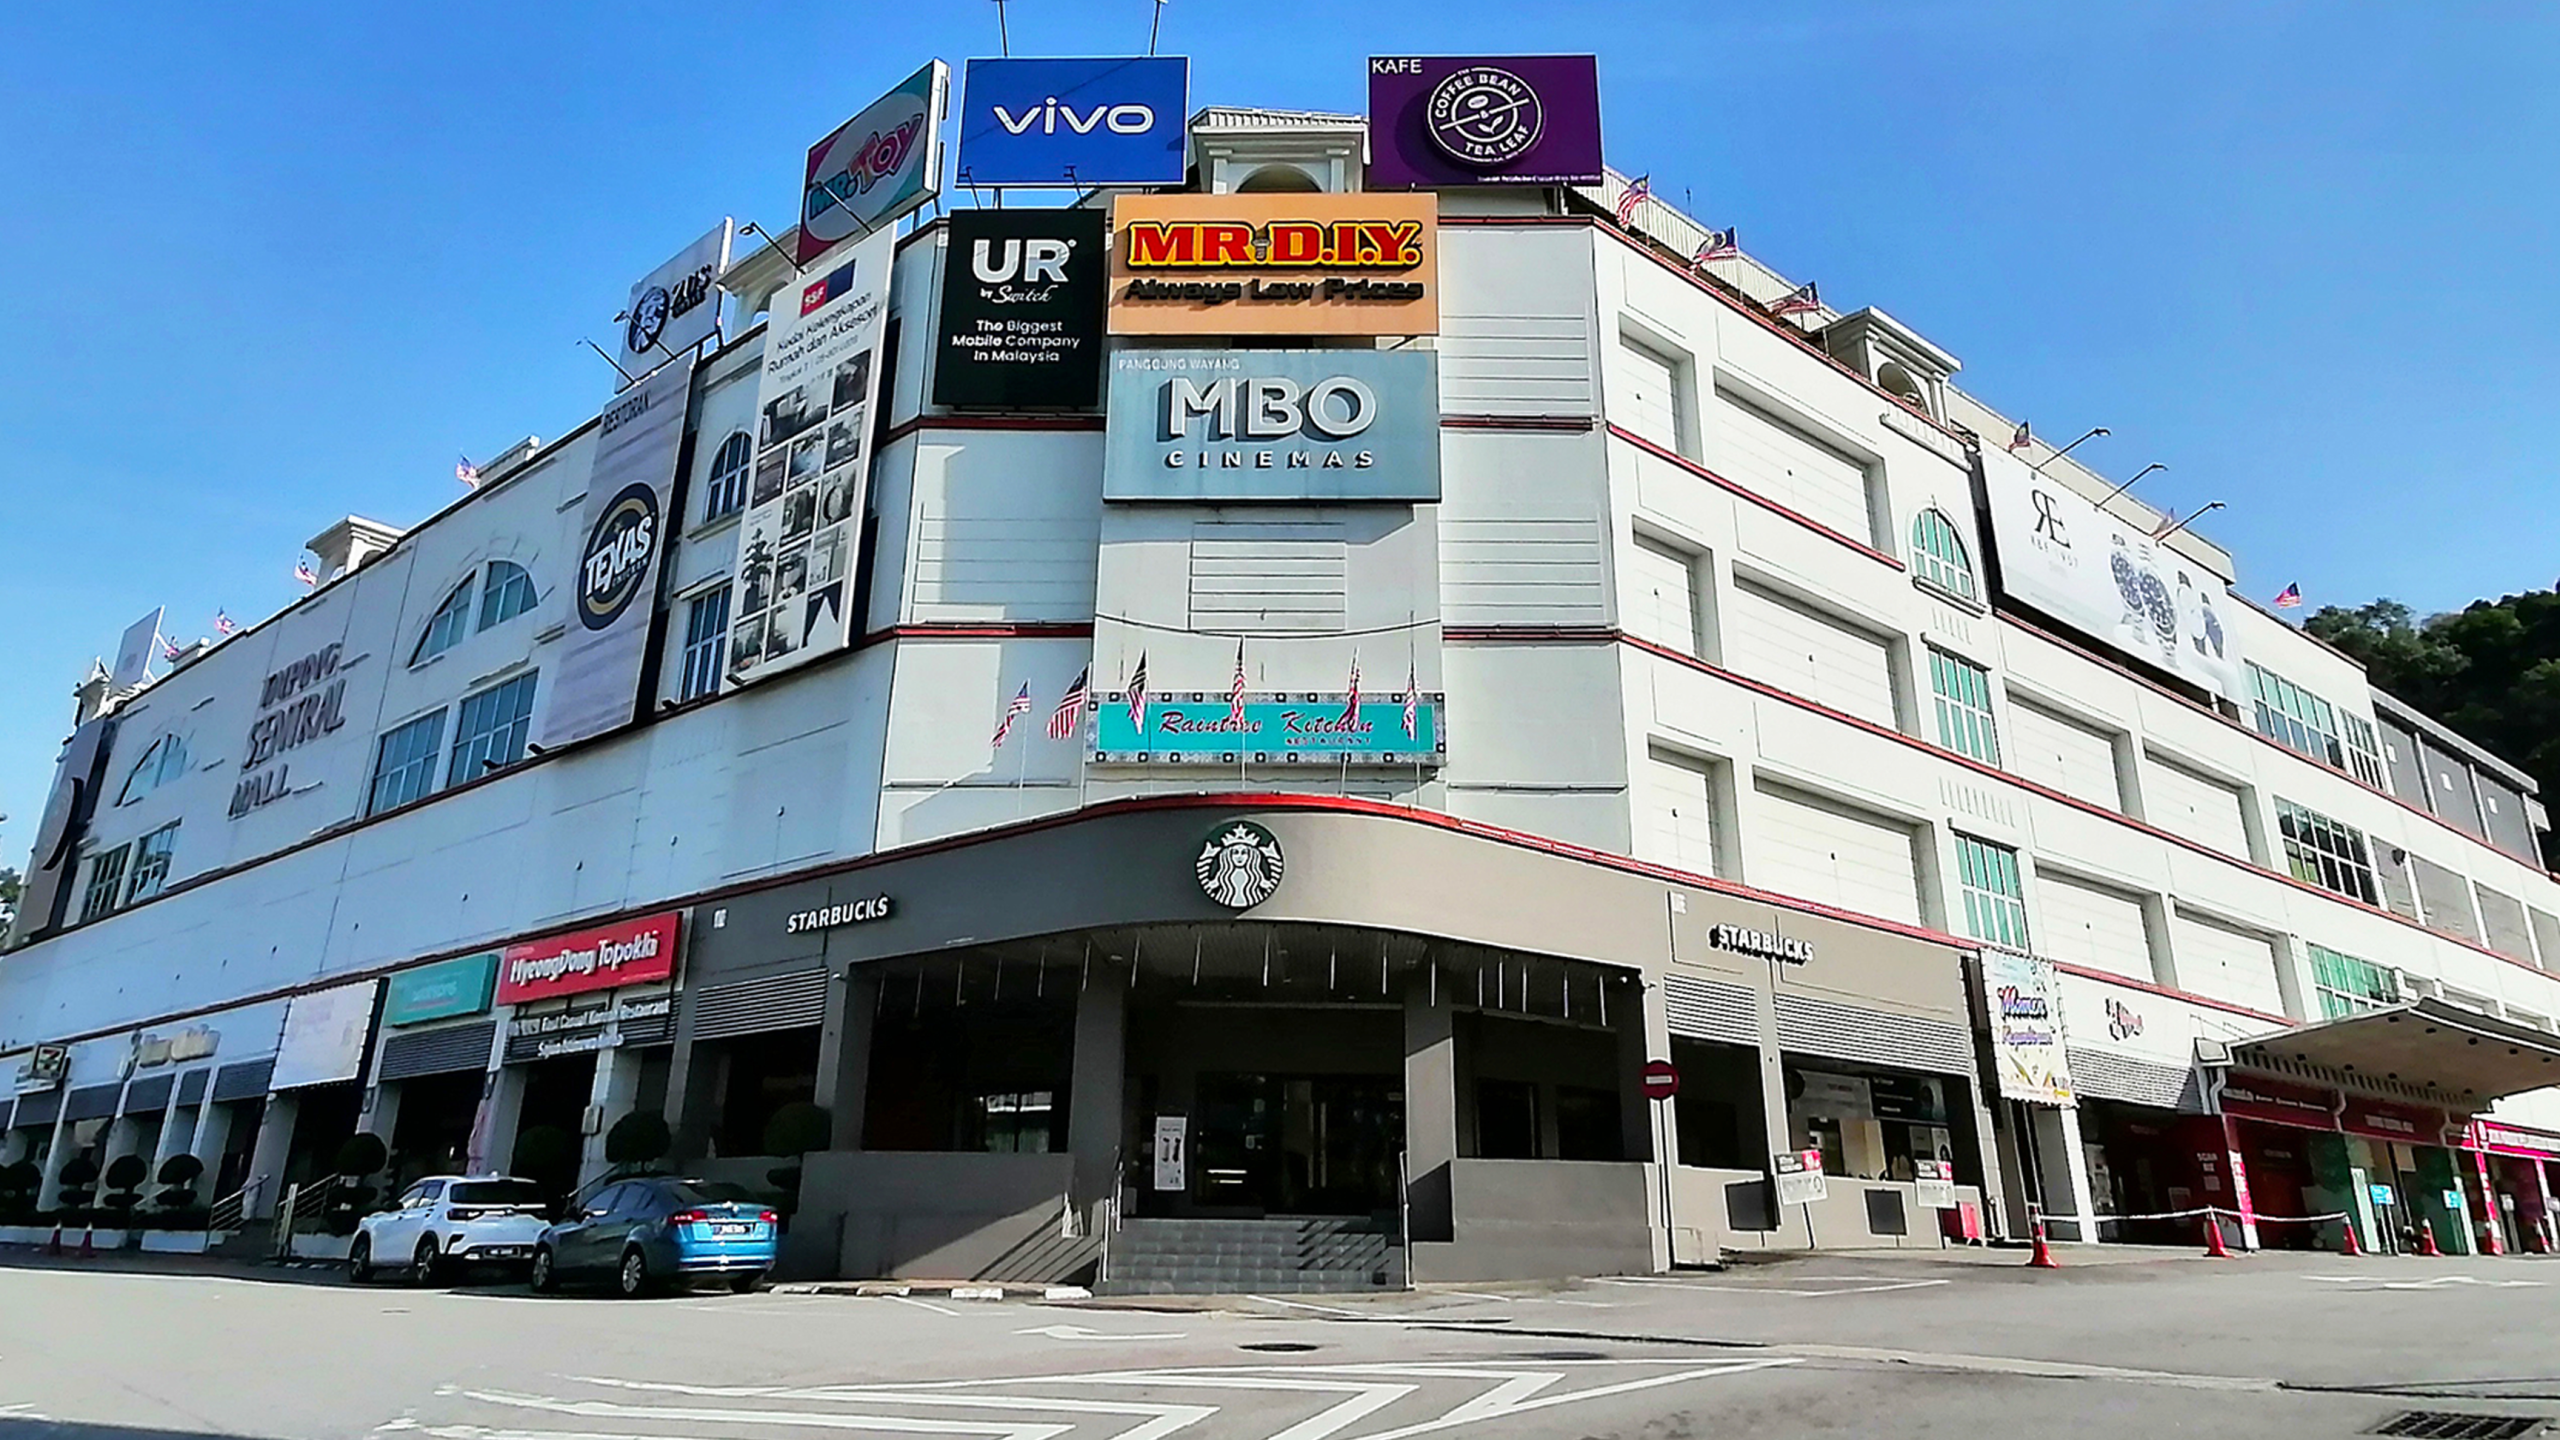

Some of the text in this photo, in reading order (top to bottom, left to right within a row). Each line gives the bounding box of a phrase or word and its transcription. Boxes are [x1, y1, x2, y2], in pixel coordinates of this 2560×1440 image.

[1371, 59, 1423, 75] KAFE
[1435, 74, 1522, 118] COFFEE BEAN
[993, 96, 1154, 134] vivo
[850, 113, 924, 194] TOY
[1465, 125, 1529, 155] TEA LEAF
[1267, 222, 1422, 267] D.I.Y.
[980, 288, 994, 300] by
[1125, 279, 1424, 303] Always Low Prices
[952, 335, 1081, 349] Mobile Company
[976, 320, 1063, 334] The Biggest
[767, 346, 804, 375] Rumah
[806, 330, 828, 354] dan
[991, 350, 1060, 363] Malaysia
[1118, 359, 1240, 371] PANGGUNG WAYANG
[1160, 376, 1377, 440] MBO
[1167, 451, 1374, 468] CINEMAS
[585, 516, 652, 596] TEXAS
[241, 679, 346, 770] SENTRAL
[228, 763, 291, 816] MALL
[787, 897, 888, 933] STARBUCKS
[1718, 924, 1814, 961] STARBUCKS
[509, 948, 596, 987] HyeongDong
